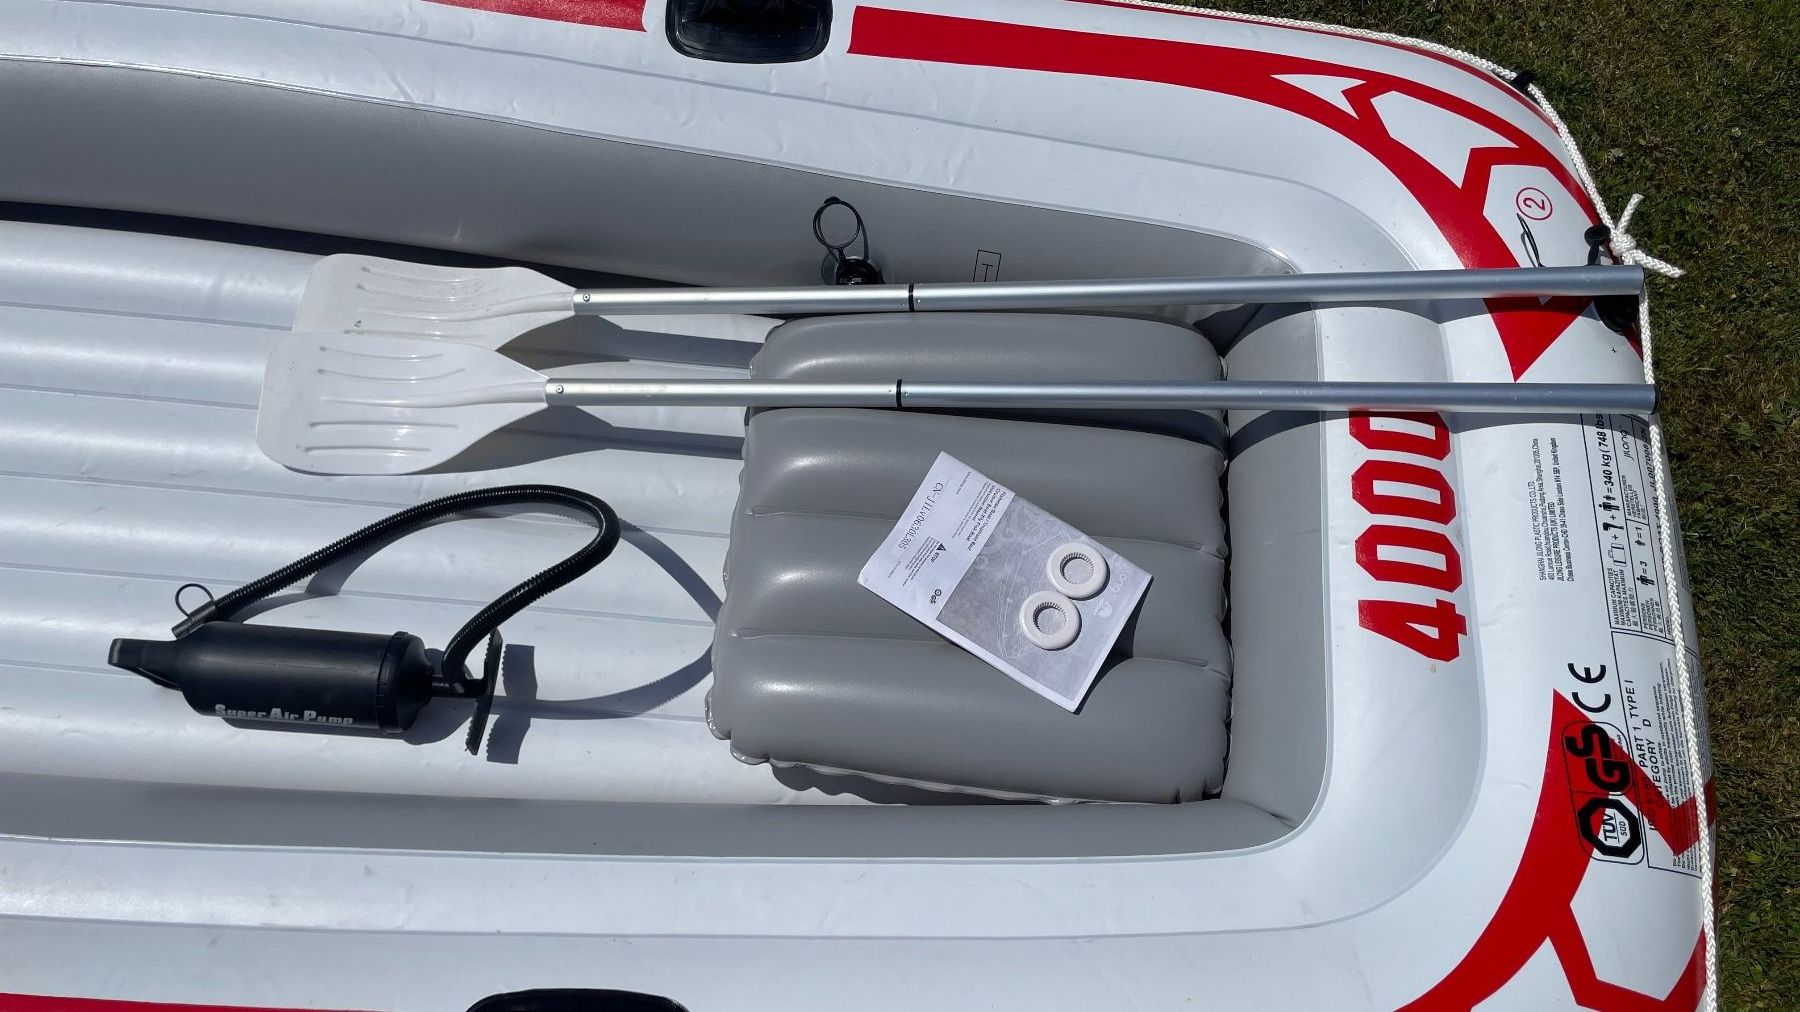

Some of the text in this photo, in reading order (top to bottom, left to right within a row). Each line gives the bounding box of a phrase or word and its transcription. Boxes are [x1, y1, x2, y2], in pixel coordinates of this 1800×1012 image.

[1348, 409, 1467, 662] 4000
[1607, 567, 1616, 598] CAPACITIES
[1567, 662, 1611, 713] CE
[1627, 687, 1639, 719] TYPE
[214, 703, 354, 725] Super Air Pump
[1642, 718, 1652, 727] D
[1634, 735, 1648, 768] PART
[1603, 813, 1617, 841] TÜV
